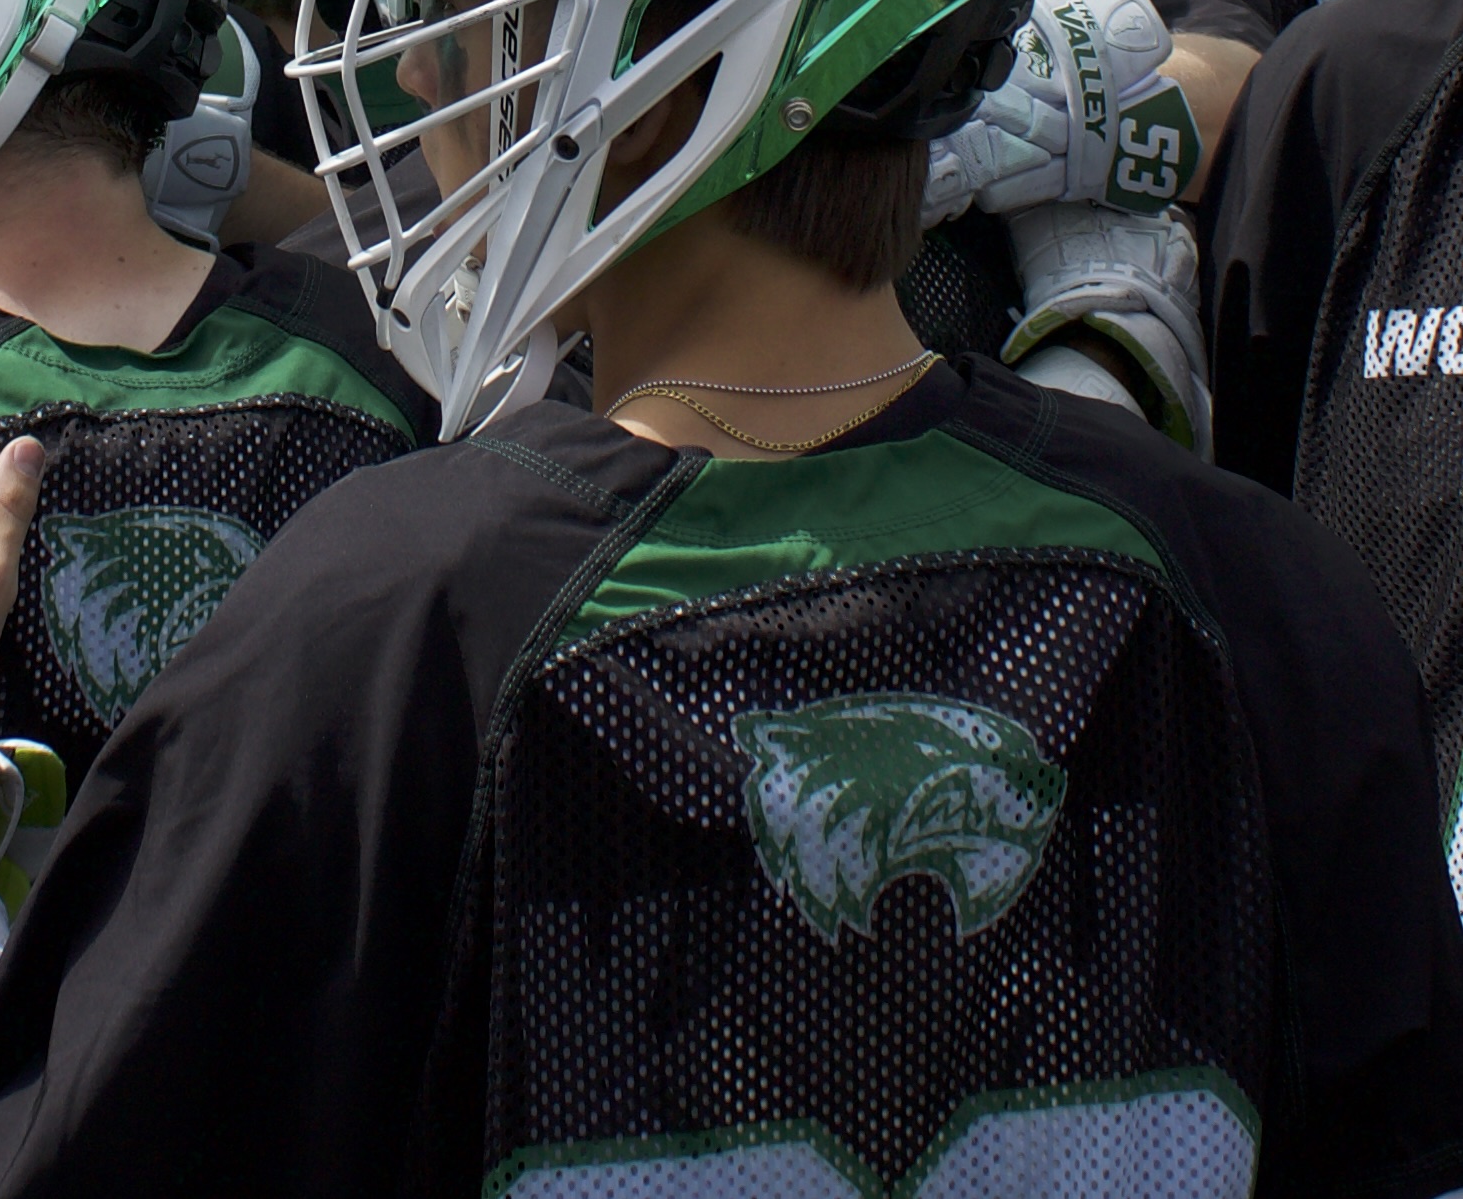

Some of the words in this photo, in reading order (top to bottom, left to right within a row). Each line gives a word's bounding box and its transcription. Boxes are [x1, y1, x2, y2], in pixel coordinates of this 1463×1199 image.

[1073, 0, 1100, 31] THE
[1052, 2, 1107, 143] VALLEY
[1116, 116, 1181, 199] 53
